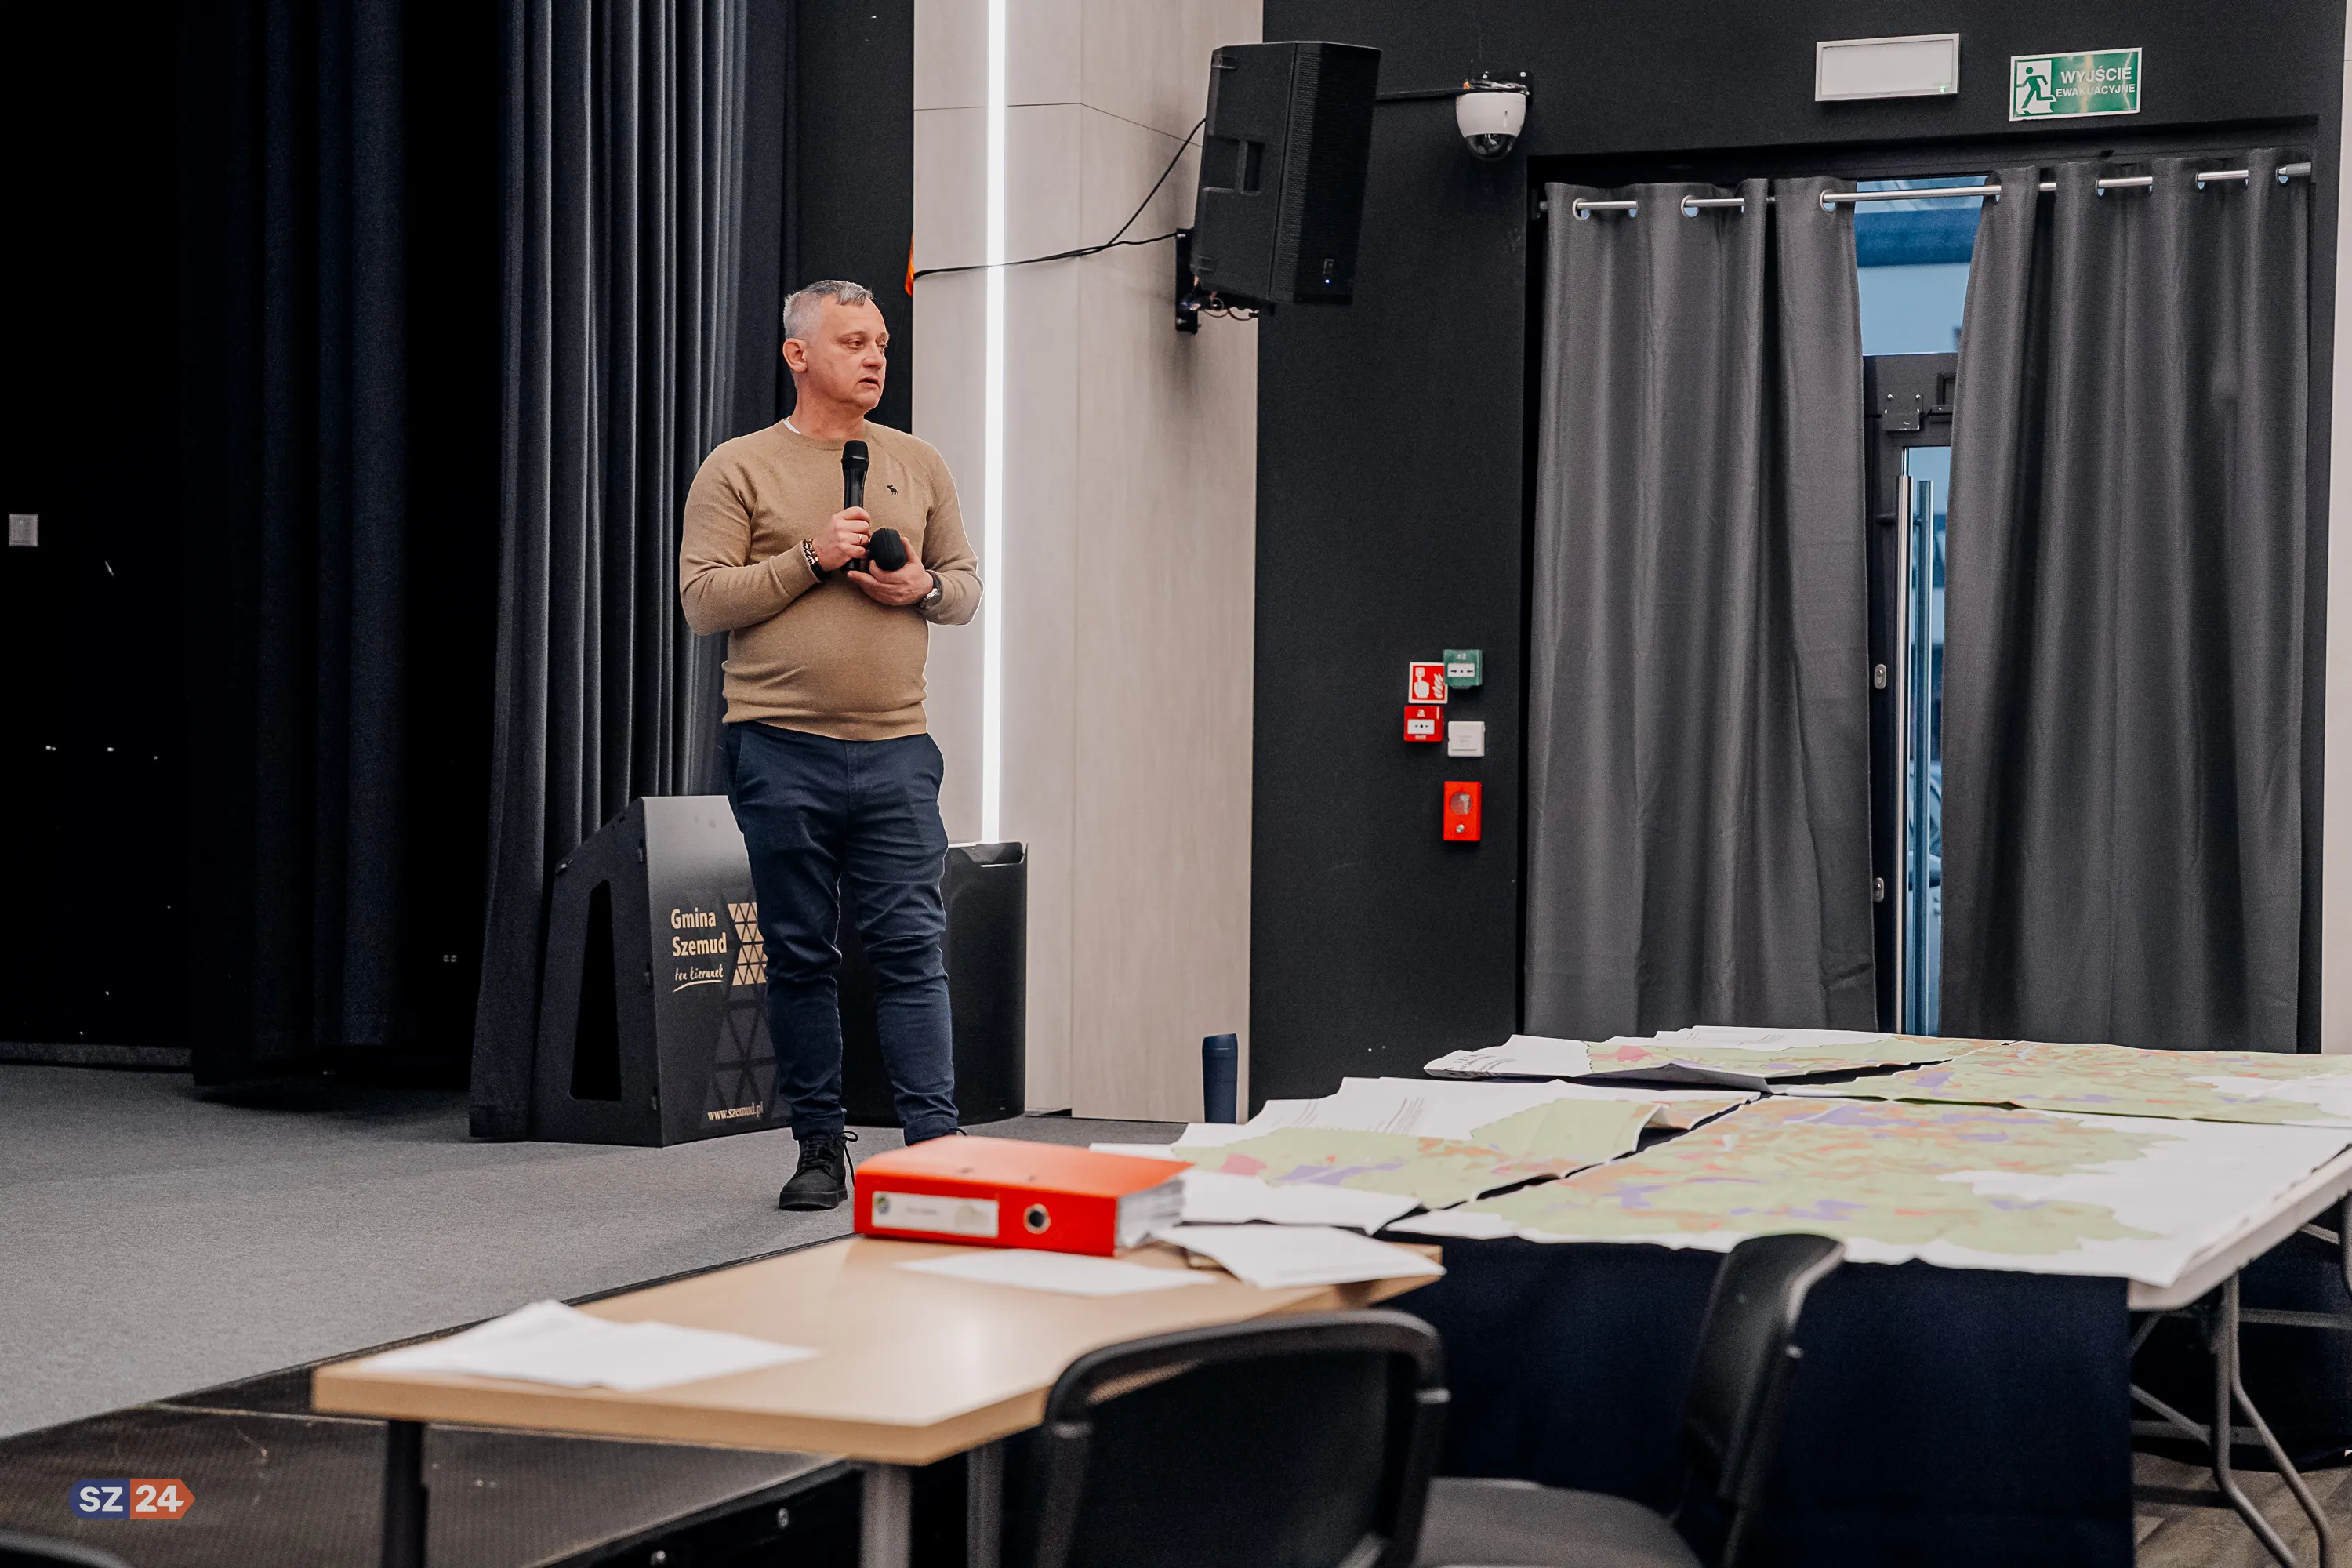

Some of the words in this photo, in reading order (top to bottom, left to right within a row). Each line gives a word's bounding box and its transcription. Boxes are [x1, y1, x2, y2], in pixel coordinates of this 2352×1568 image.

[2060, 65, 2132, 84] WYJŚCIE
[2056, 83, 2136, 97] EWAKUACYJNE
[670, 907, 717, 929] Gmina
[672, 931, 728, 957] Szemud
[707, 1101, 764, 1121] www.szemud.pl
